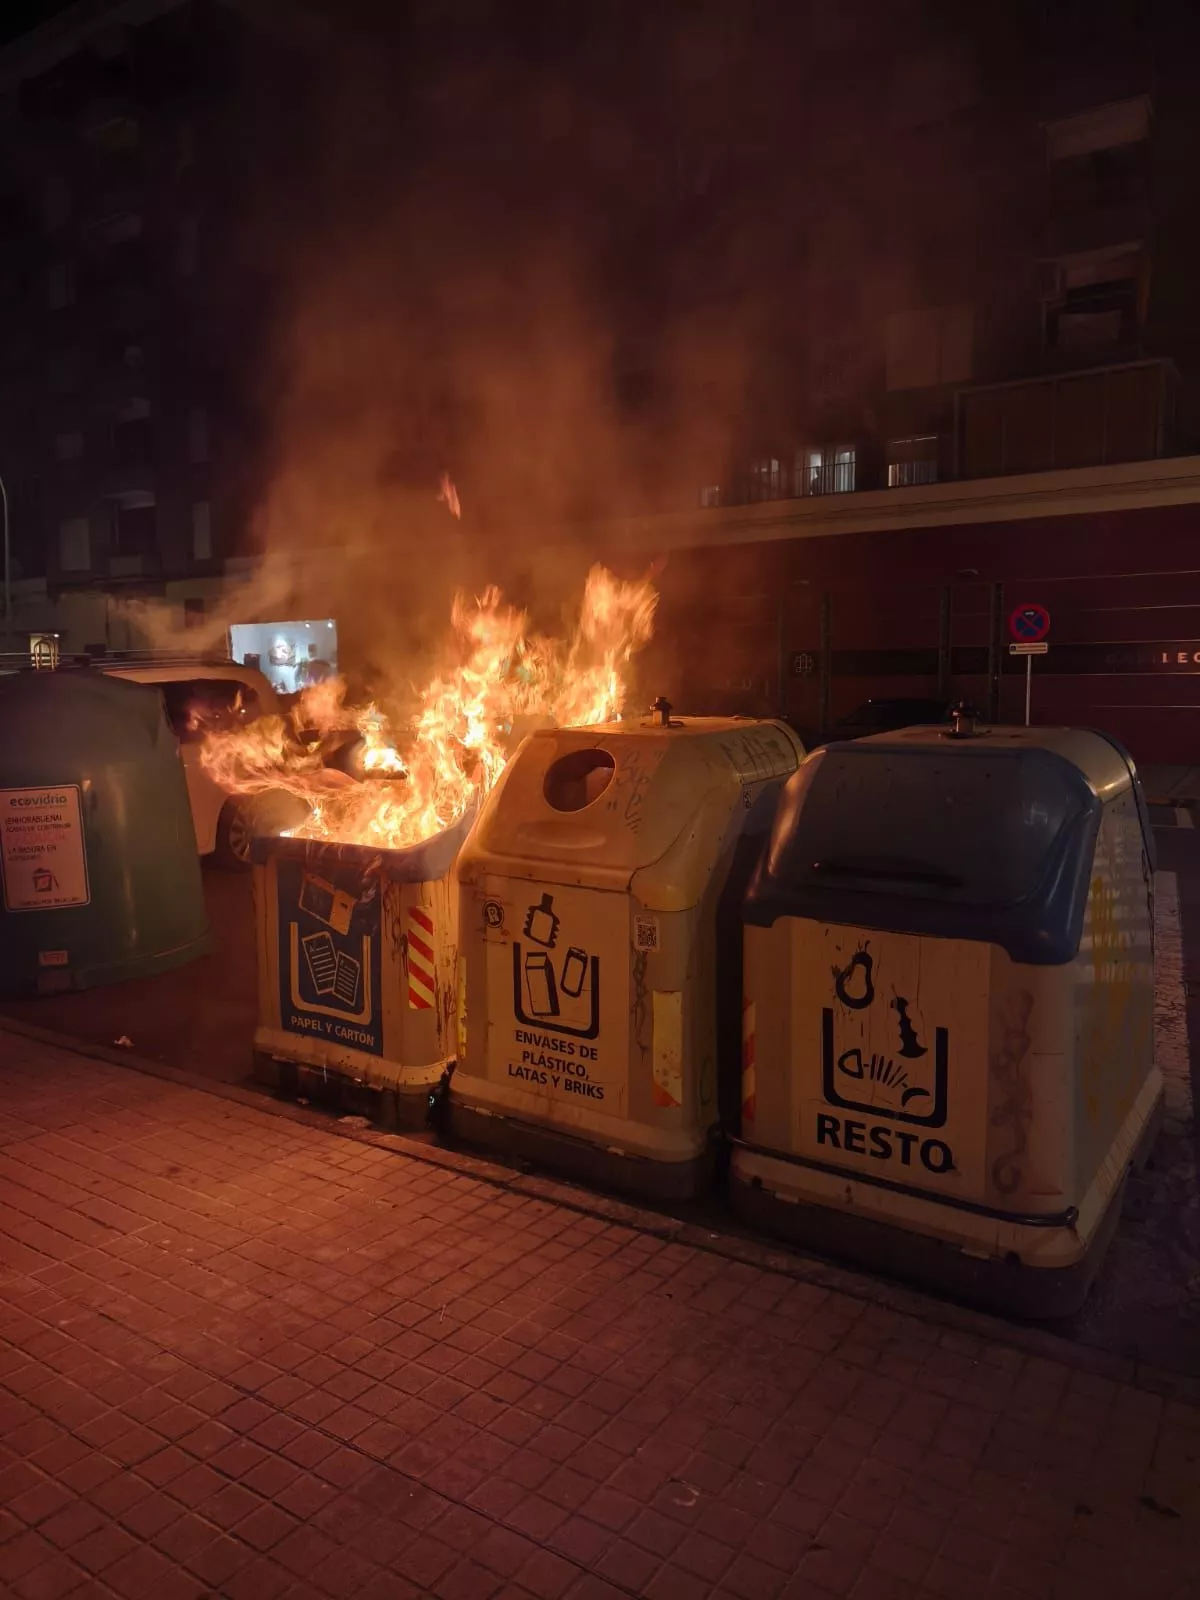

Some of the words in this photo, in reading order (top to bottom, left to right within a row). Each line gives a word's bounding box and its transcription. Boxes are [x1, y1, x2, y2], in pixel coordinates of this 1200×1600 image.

[10, 793, 67, 807] ecovidrio
[291, 1015, 323, 1032] PAPEL
[325, 1023, 333, 1033] Y
[515, 1030, 575, 1055] ENVASES
[579, 1045, 598, 1061] DE
[522, 1050, 590, 1081] PLÁSTICO,
[508, 1064, 547, 1085] LATAS
[551, 1075, 561, 1088] Y
[564, 1078, 605, 1100] BRIKS
[817, 1113, 954, 1173] RESTO
